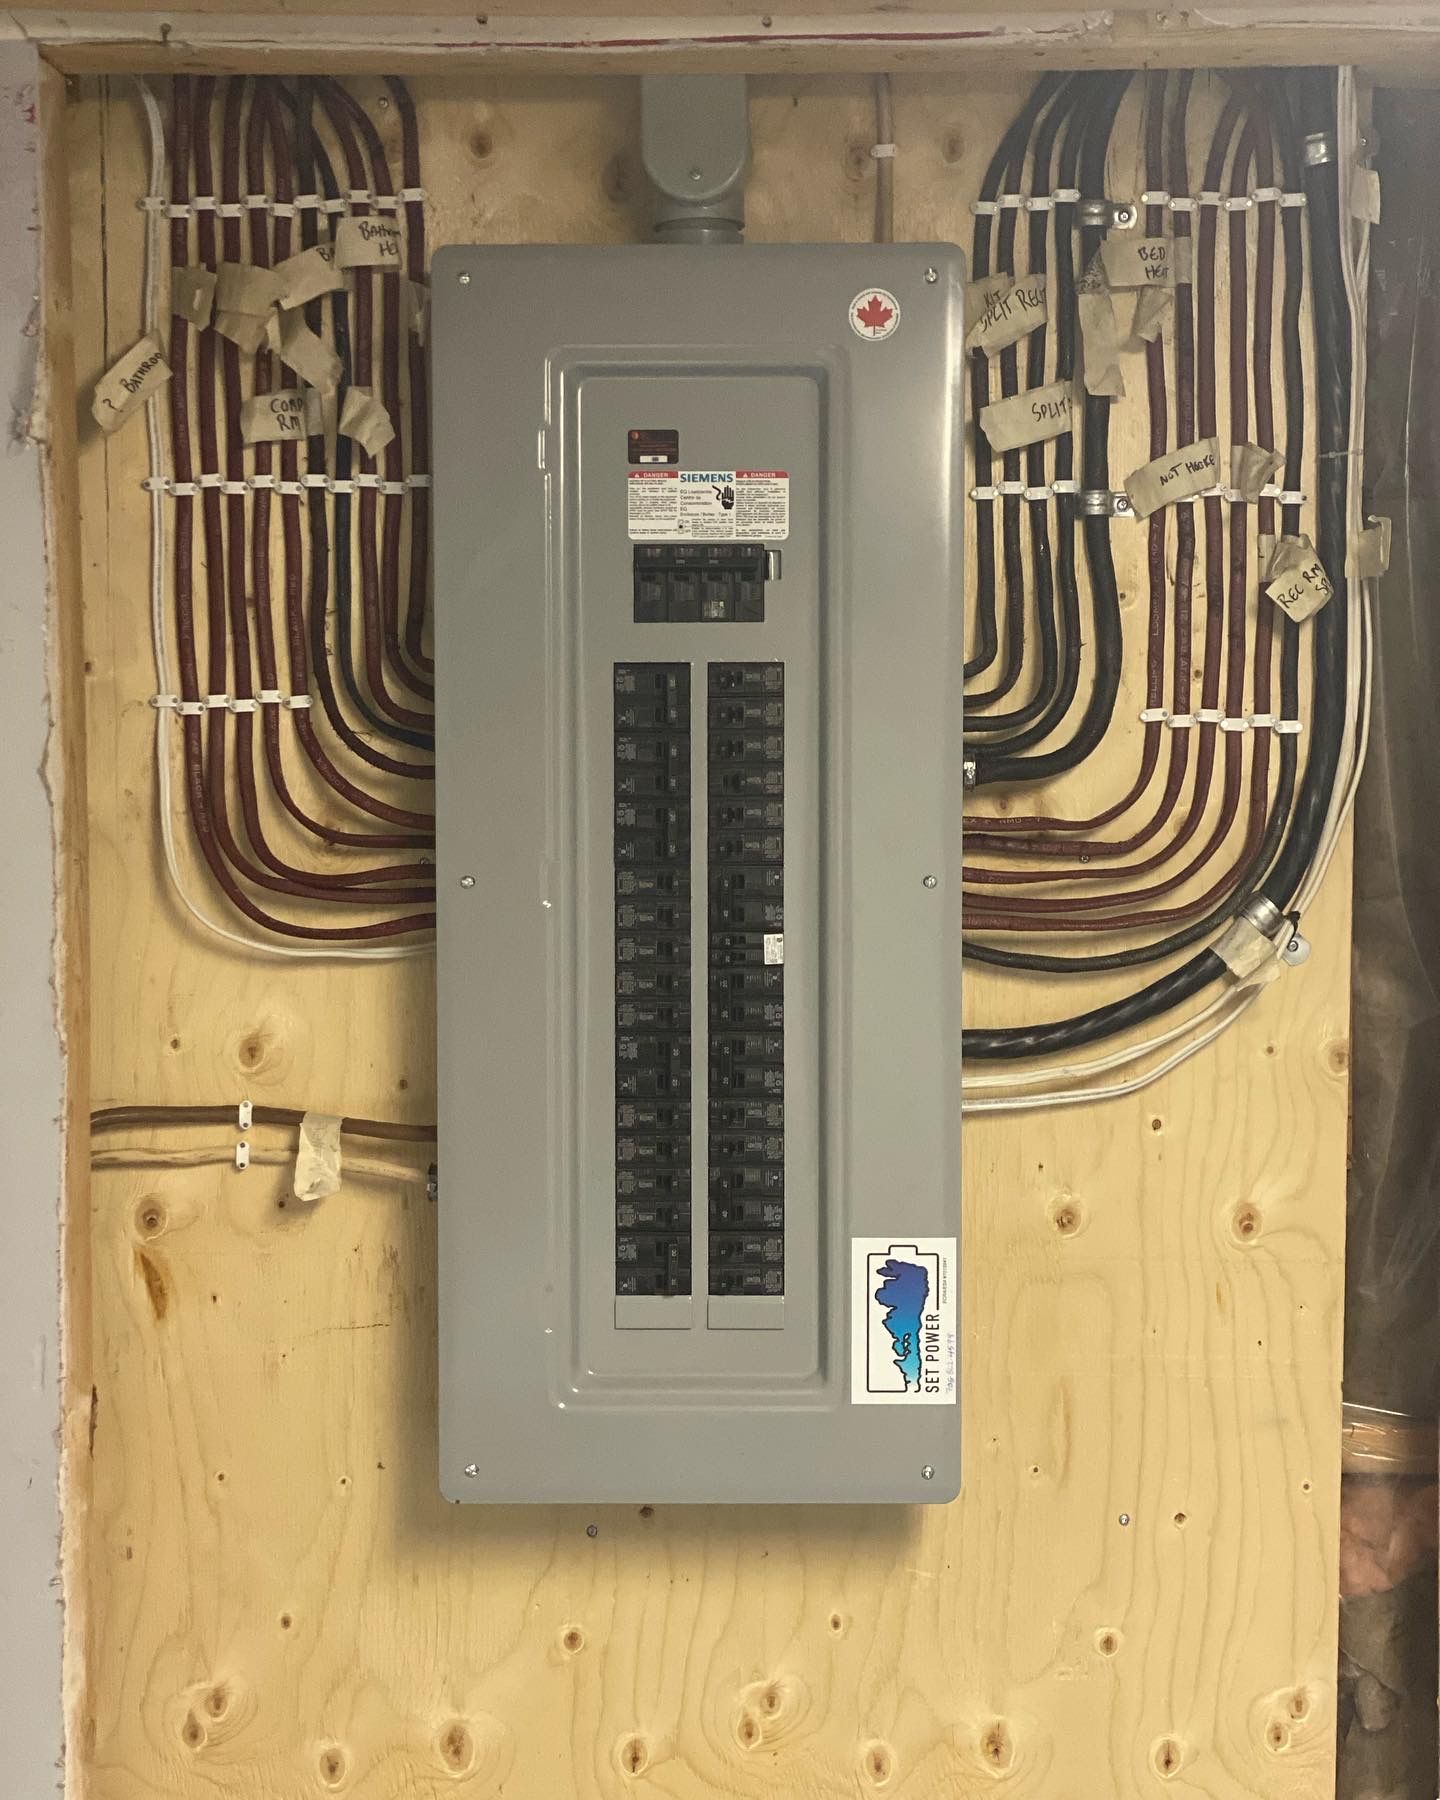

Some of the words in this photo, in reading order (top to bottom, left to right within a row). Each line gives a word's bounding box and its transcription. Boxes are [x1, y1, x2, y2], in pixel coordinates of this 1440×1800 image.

[1138, 246, 1166, 261] BED
[276, 413, 301, 431] RM
[680, 473, 734, 483] SIEMENS
[1159, 462, 1183, 486] NOT
[1277, 584, 1304, 609] REC
[925, 1313, 940, 1362] POWER
[925, 1368, 940, 1393] SET
